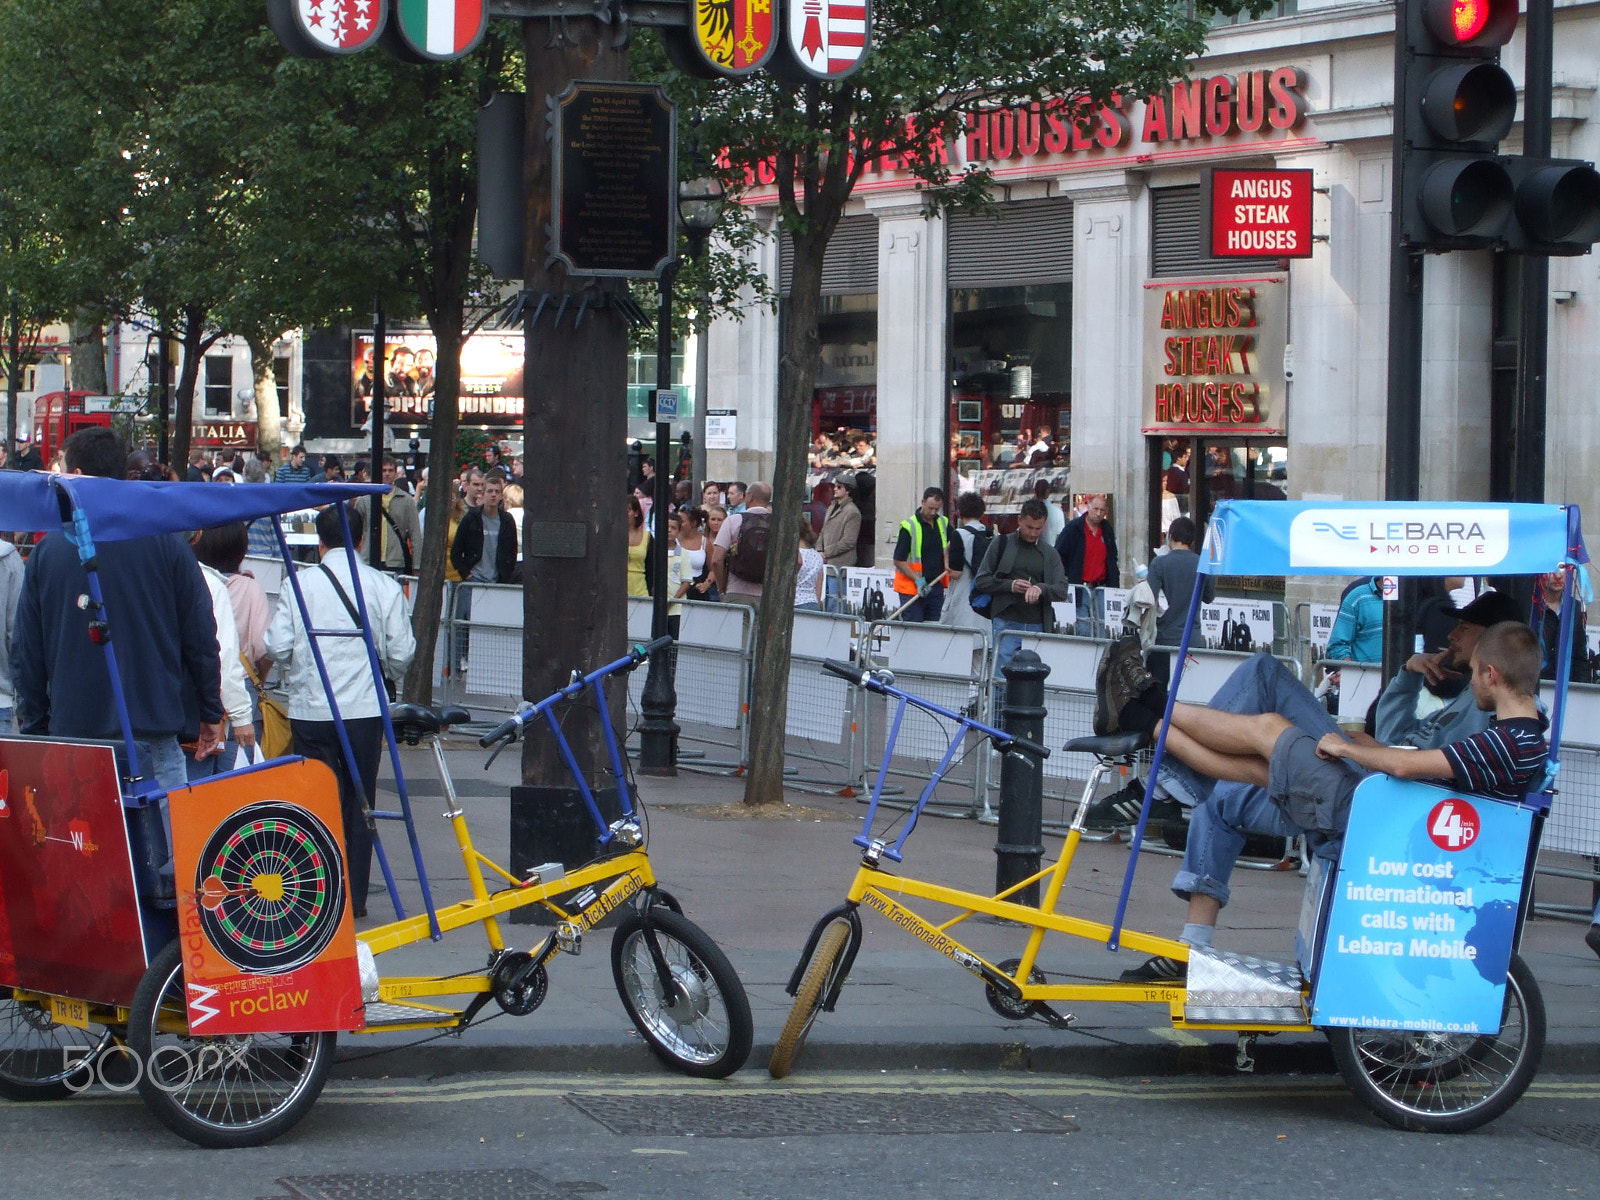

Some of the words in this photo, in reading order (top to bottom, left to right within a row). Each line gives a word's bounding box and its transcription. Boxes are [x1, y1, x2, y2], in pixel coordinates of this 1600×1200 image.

[966, 89, 1127, 162] HOUSES
[1141, 67, 1299, 142] ANGUS
[1230, 179, 1293, 199] ANGUS
[1234, 204, 1290, 224] STEAK
[1227, 230, 1298, 250] HOUSES
[1160, 287, 1244, 329] ANGUS
[1163, 335, 1236, 376] STEAK
[1155, 381, 1247, 423] HOUSES
[191, 424, 247, 439] ITALIA
[1369, 521, 1487, 541] LEBARA
[1386, 544, 1486, 555] MOBILE
[1202, 608, 1208, 621] DE
[1208, 608, 1220, 621] NIRO
[1252, 608, 1271, 622] PACINO
[1312, 615, 1319, 628] DE
[1319, 616, 1332, 629] NIRO
[1368, 856, 1409, 877] Low
[1412, 860, 1454, 879] cost
[1346, 881, 1474, 907] international
[1360, 910, 1408, 931] calls
[1411, 912, 1456, 932] with
[1337, 935, 1404, 957] Lebara
[1409, 939, 1477, 961] Mobile
[384, 985, 398, 997] TR
[399, 985, 413, 996] 152
[1143, 990, 1157, 1001] TR
[1160, 989, 1179, 1001] 164
[55, 999, 68, 1018] TR
[69, 1001, 84, 1021] 152
[1328, 1015, 1479, 1033] www.lebara-mobile.co.uk
